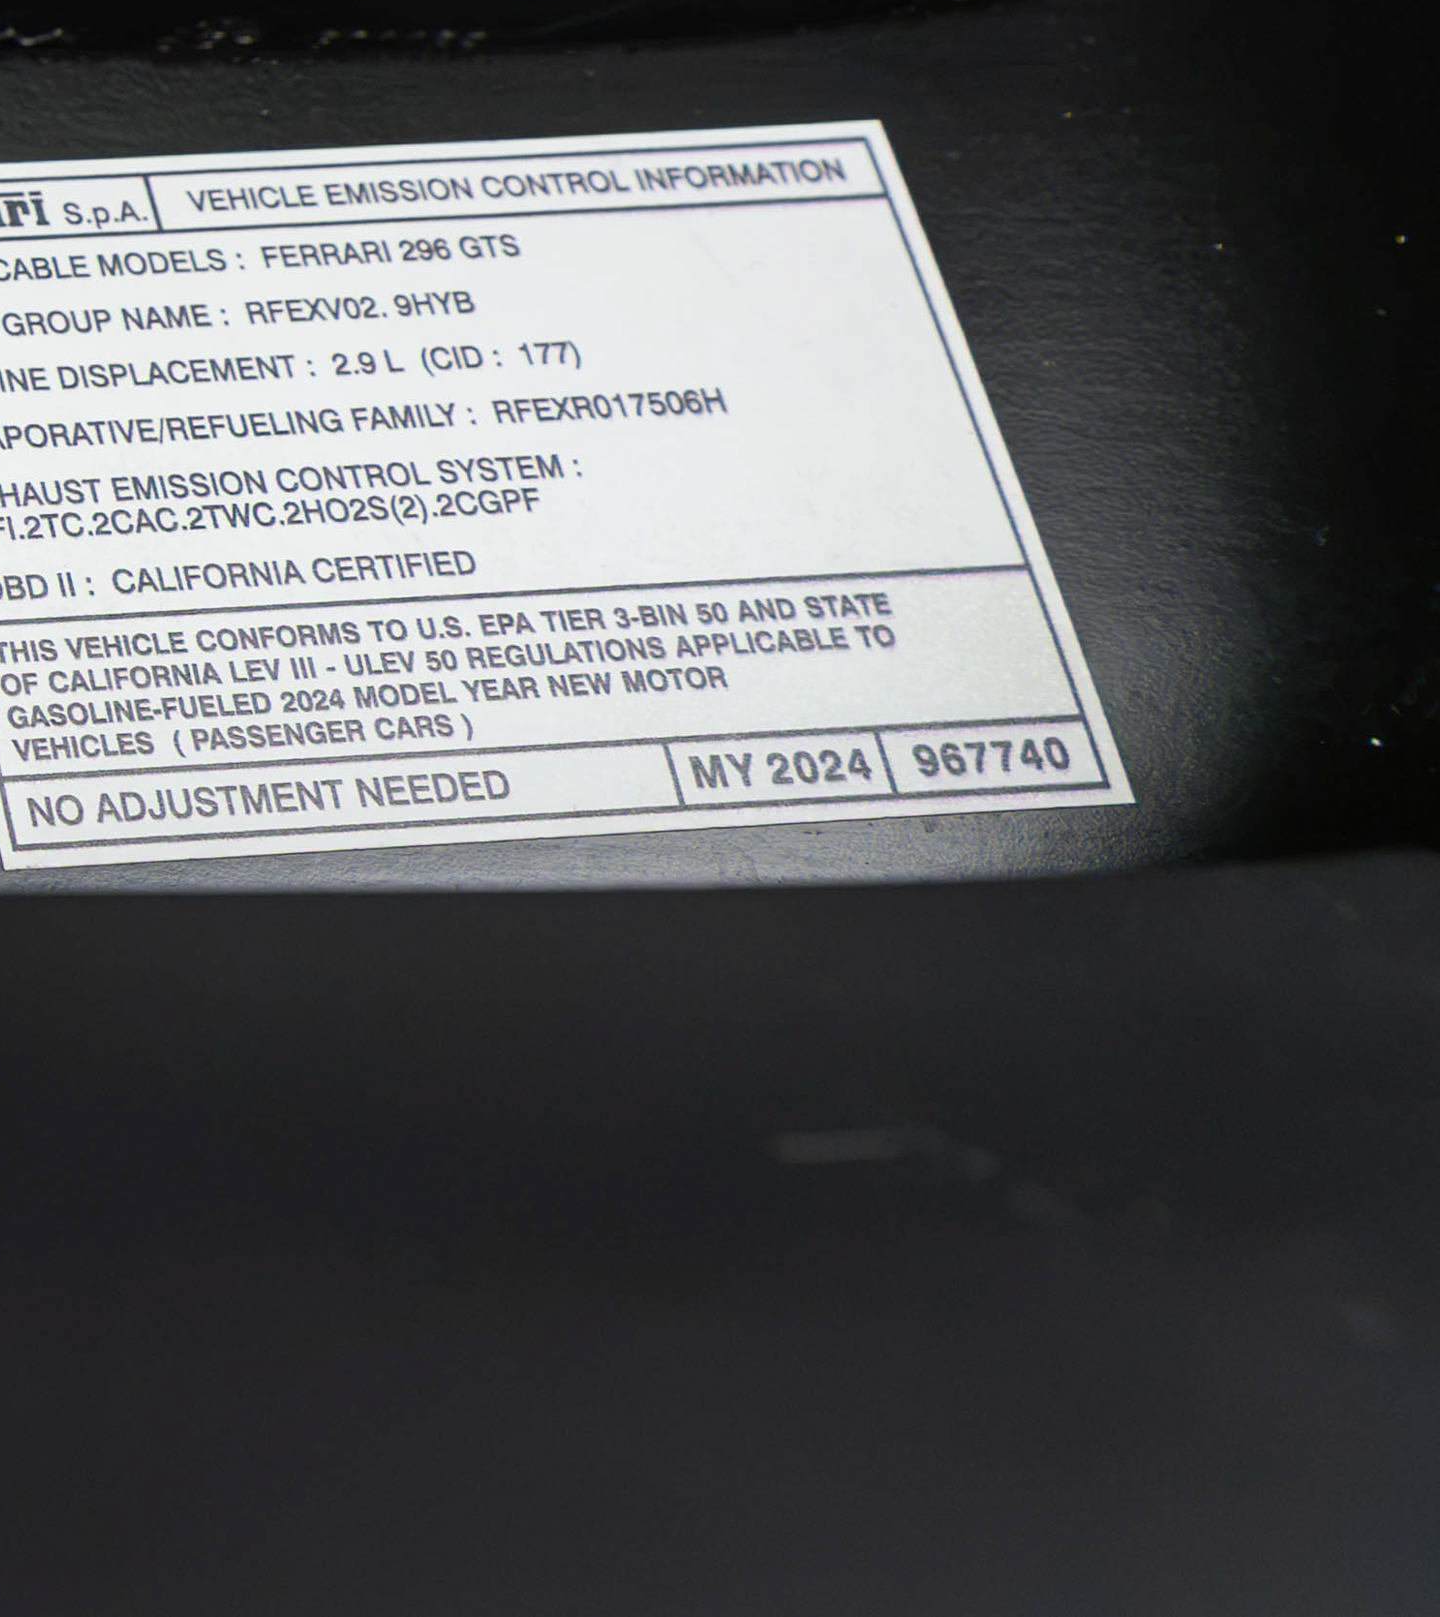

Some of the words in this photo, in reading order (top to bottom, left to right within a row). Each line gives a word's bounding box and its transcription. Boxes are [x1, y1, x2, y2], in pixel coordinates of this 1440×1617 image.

[186, 184, 319, 213] VEHICLE
[323, 177, 474, 206] EMISSION
[480, 170, 631, 199] CONTROL
[634, 159, 847, 191] INFORMATION
[62, 200, 149, 230] S.p.A.
[96, 248, 227, 277] MODELS
[260, 240, 393, 269] FERRARI
[398, 237, 452, 262] 296
[458, 233, 521, 260] GTS
[1, 308, 112, 337] GROUP
[120, 303, 213, 332] NAME
[56, 354, 295, 390] DISPLACEMENT
[331, 351, 377, 376] 2.9
[383, 349, 406, 374] L
[420, 345, 484, 377] (CID
[518, 340, 582, 370] 177)
[349, 402, 455, 432] FAMILY
[491, 387, 728, 424] RFEXR017506H
[110, 469, 269, 503] EMISSION
[275, 461, 433, 494] CONTROL
[436, 453, 565, 485] SYSTEM
[56, 571, 77, 598] II
[111, 559, 307, 595] CALIFORNIA
[311, 550, 477, 584] CERTIFIED
[63, 631, 189, 660] VEHICLE
[195, 621, 361, 653] CONFORMS
[365, 618, 409, 643] TO
[416, 615, 472, 642] U.S.
[478, 612, 535, 638] EPA
[541, 607, 607, 633] TIER
[612, 603, 689, 630] 3-BIN
[695, 601, 729, 626] 50
[738, 597, 797, 623] AND
[803, 592, 893, 620] STATE
[0, 672, 38, 697] OF
[48, 661, 224, 694] CALIFORNIA
[228, 657, 280, 684] LEV
[289, 656, 318, 681] III
[343, 650, 415, 677] ULEV
[424, 648, 458, 673] 50
[464, 636, 667, 670] REGULATIONS
[676, 626, 851, 659] APPLICABLE
[853, 624, 896, 649] TO
[6, 691, 272, 730] GASOLINE-FUELED
[279, 688, 346, 714] 2024
[353, 681, 458, 710] MODEL
[461, 675, 539, 703] YEAR
[547, 670, 614, 698] NEW
[619, 665, 730, 694] MOTOR
[10, 730, 155, 762] VEHICLES
[189, 719, 367, 752] PASSENGER
[373, 713, 455, 741] CARS
[911, 736, 1071, 778] 967740
[687, 752, 753, 789] MY
[766, 748, 873, 785] 2024
[26, 794, 85, 828] NO
[96, 778, 343, 824] ADJUSTMENT
[354, 769, 510, 808] NEEDED
